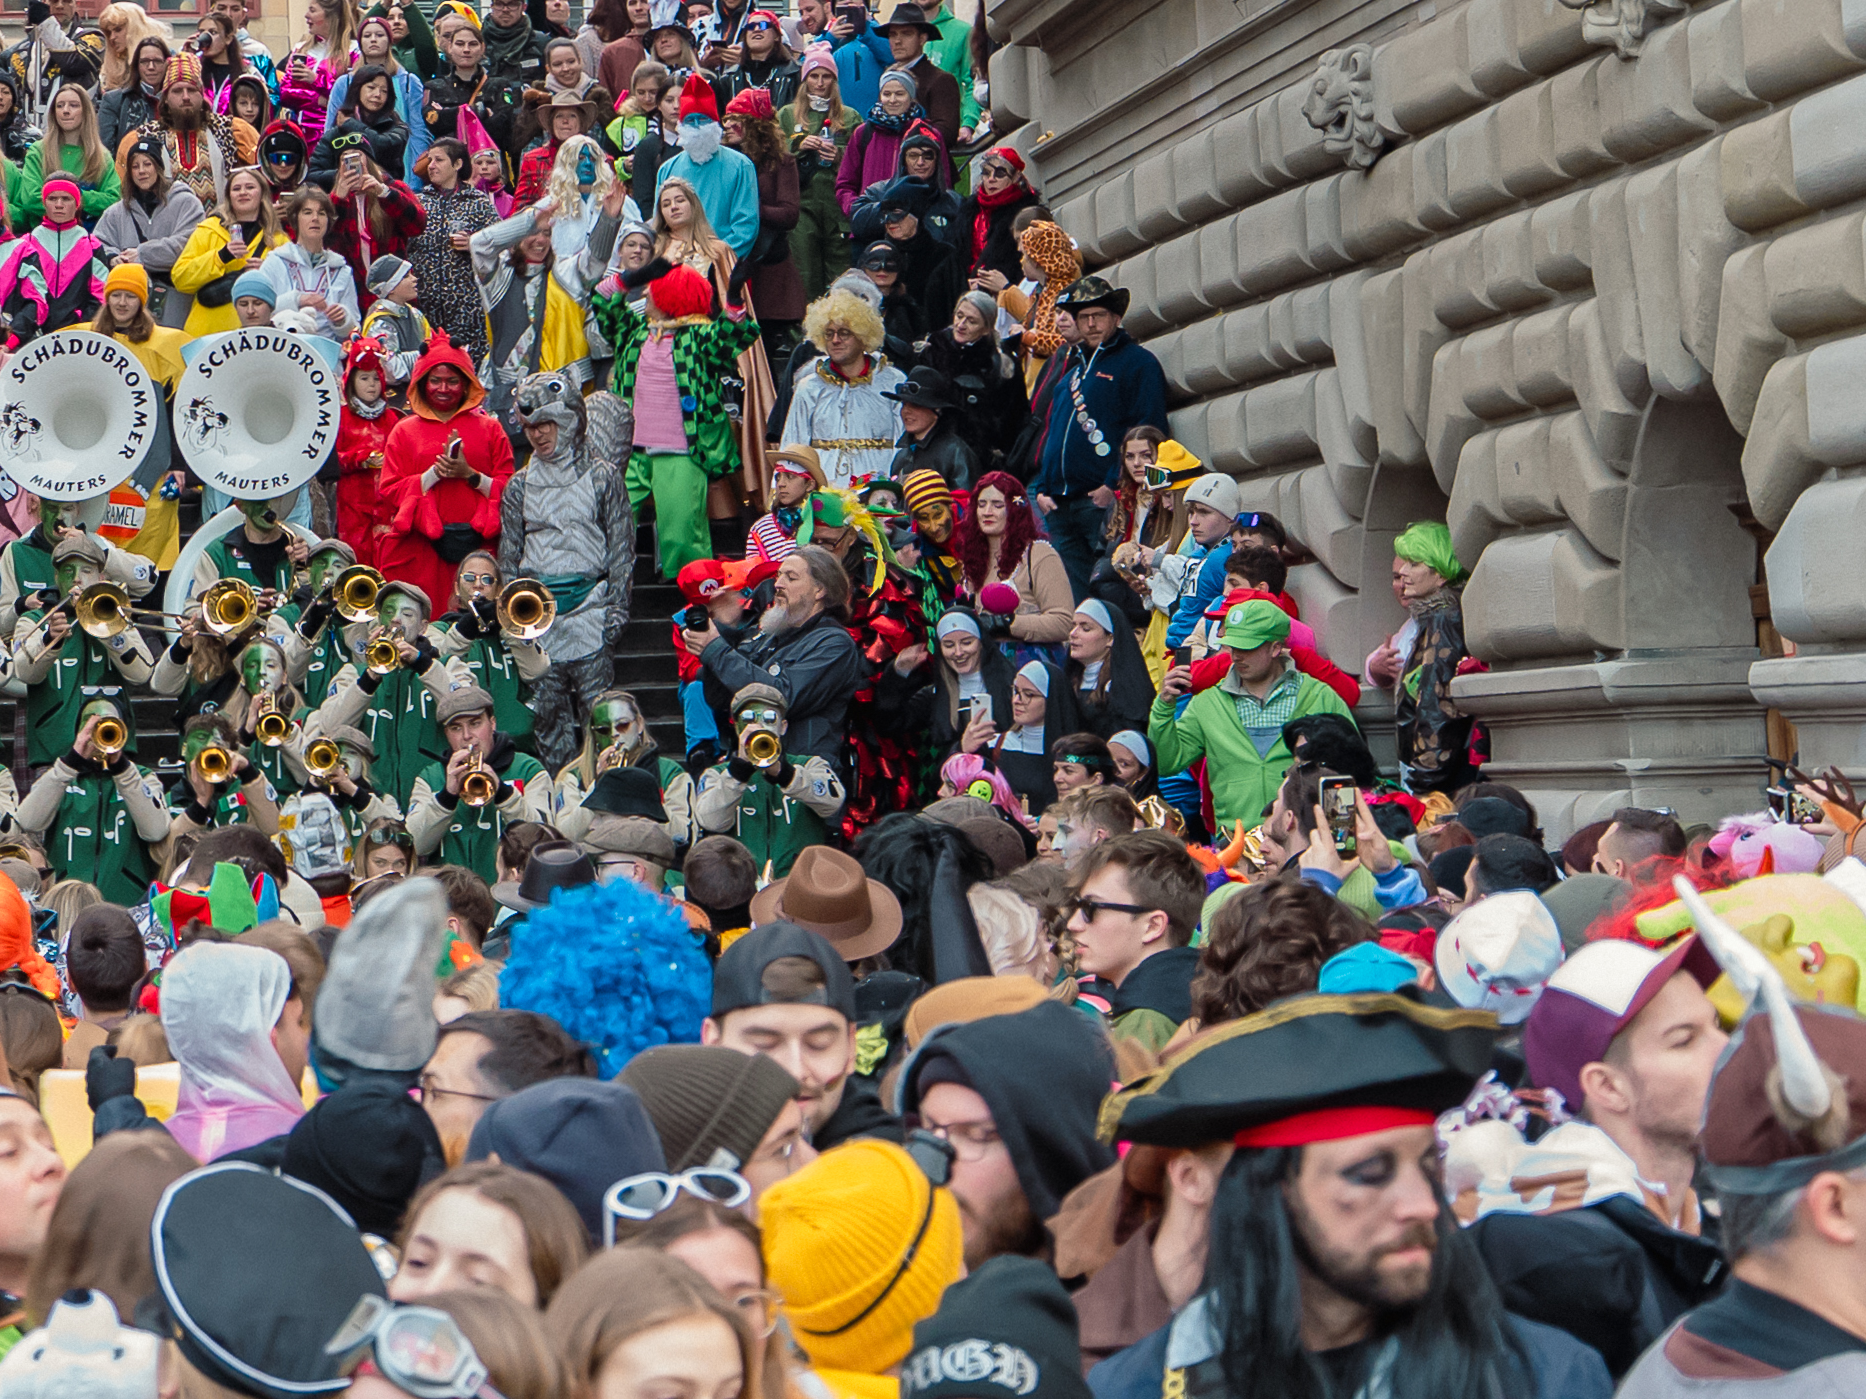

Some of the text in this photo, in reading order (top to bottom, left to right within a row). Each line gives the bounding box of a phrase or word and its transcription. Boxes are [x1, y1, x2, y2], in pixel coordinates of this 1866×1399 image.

[11, 334, 148, 460] SCHÄDUBROMMER
[198, 330, 332, 460] SCHÄDUBROMMER
[29, 473, 107, 493] MAUTERS
[214, 472, 291, 491] MAUTERS
